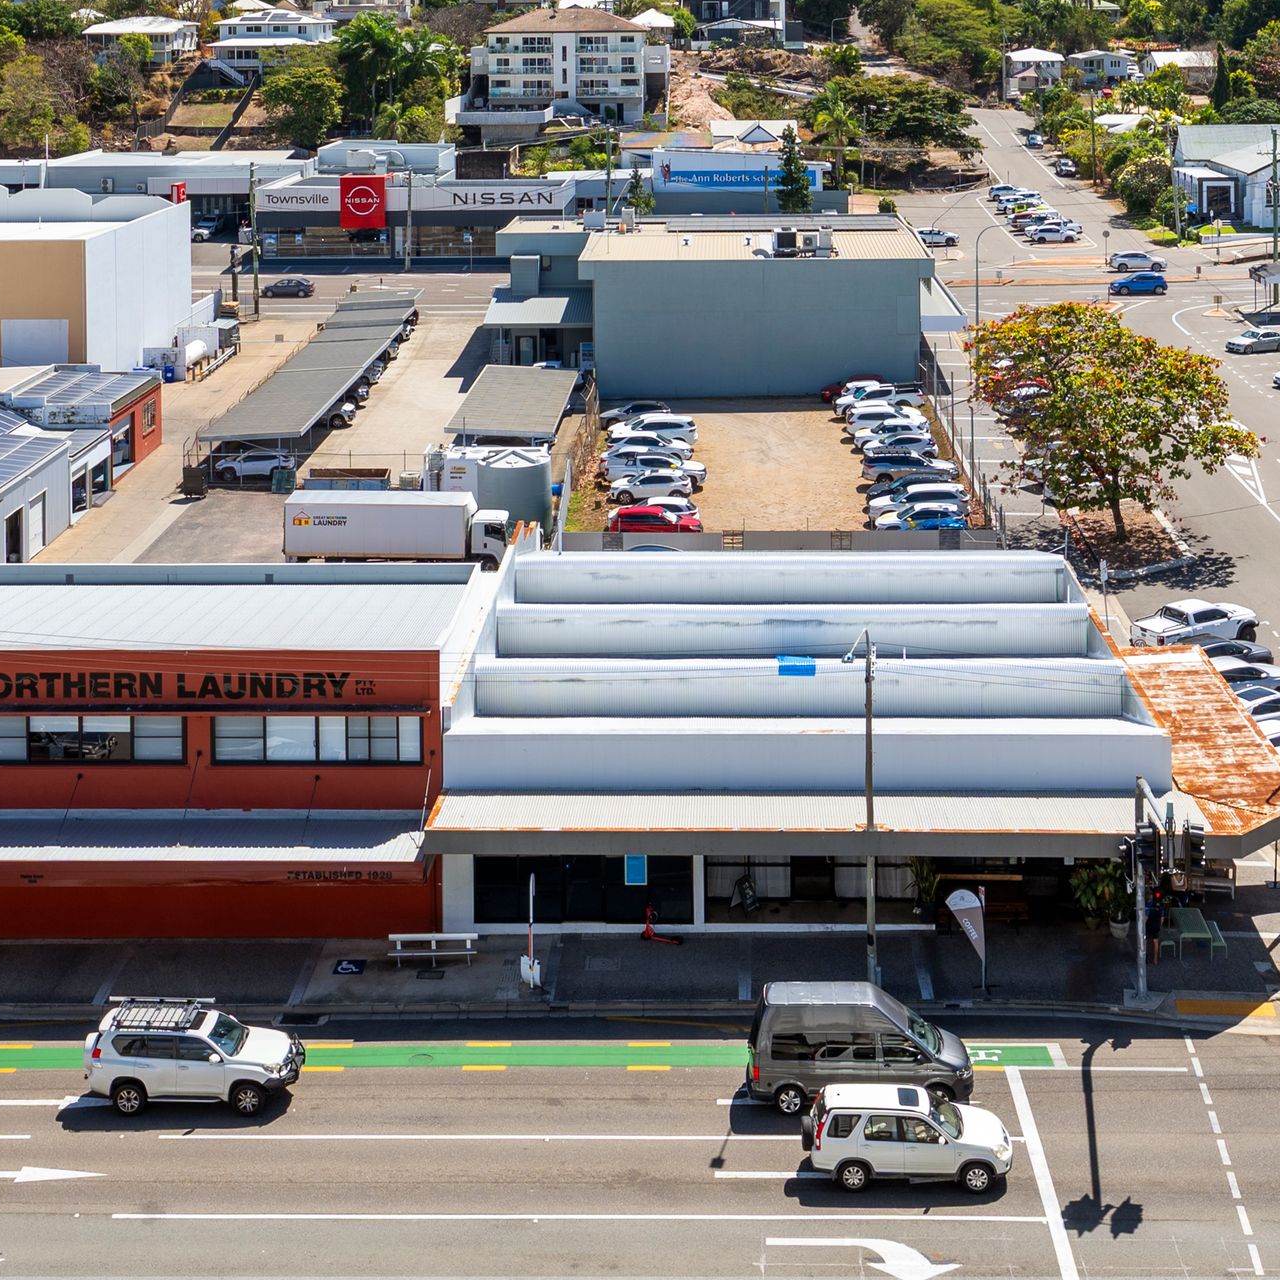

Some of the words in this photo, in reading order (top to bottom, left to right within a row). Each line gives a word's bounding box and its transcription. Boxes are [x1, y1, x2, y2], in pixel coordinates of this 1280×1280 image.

[691, 174, 710, 182] Ann
[713, 173, 750, 182] Roberts
[265, 194, 329, 204] Townsville
[453, 192, 553, 205] NISSAN
[177, 672, 351, 700] LAUNDRY
[355, 687, 376, 696] LTD.
[962, 918, 978, 940] COFFEE
